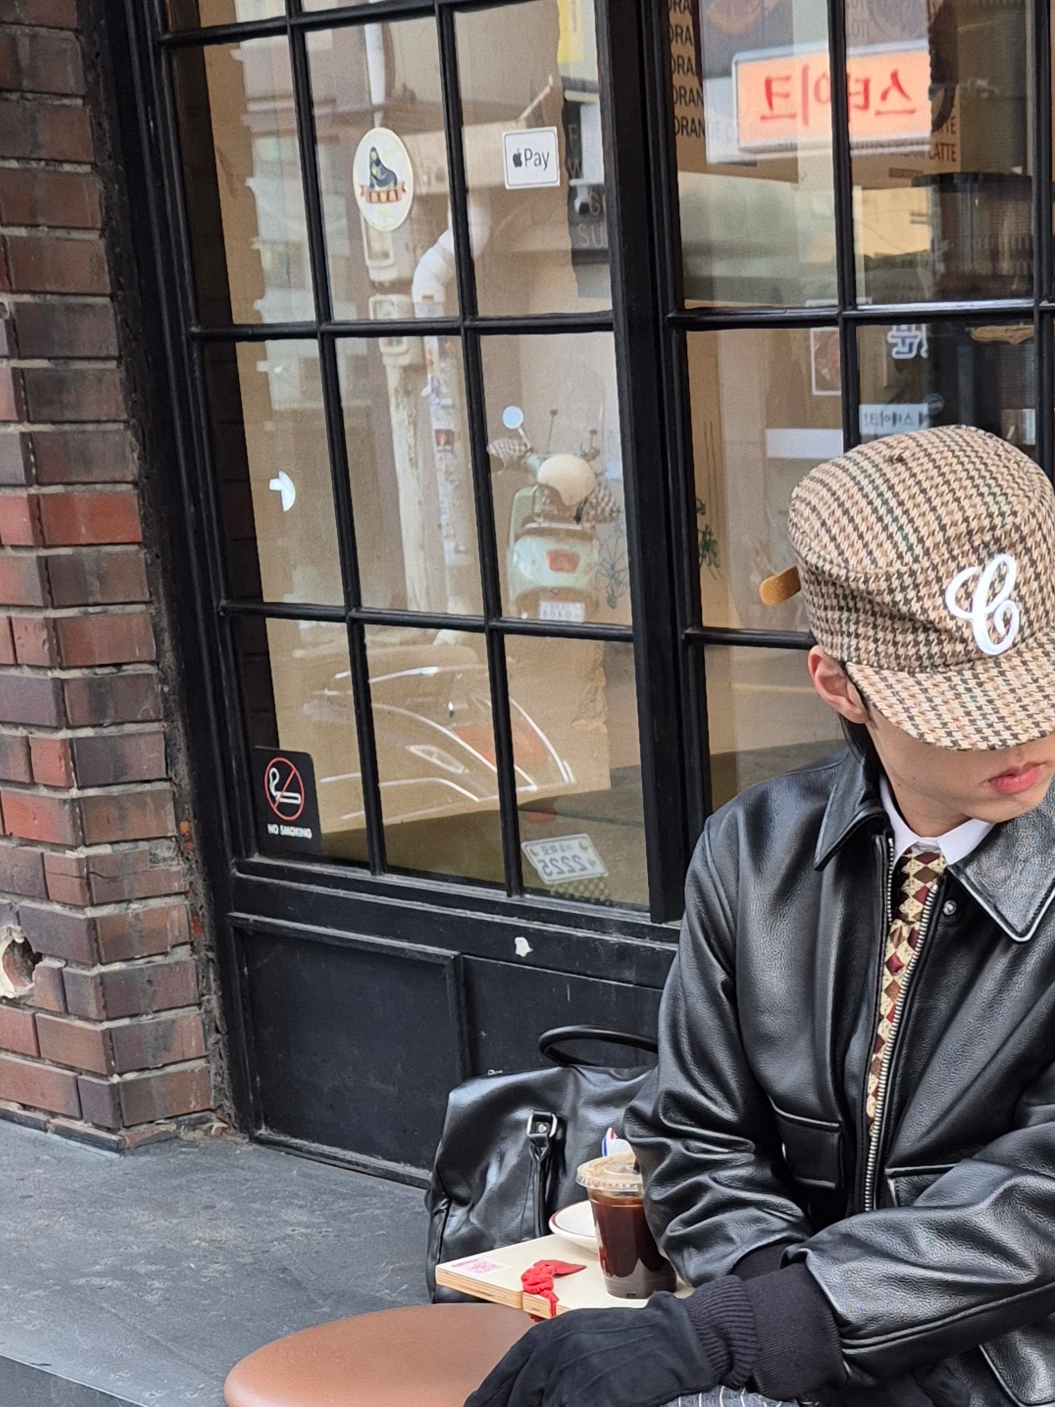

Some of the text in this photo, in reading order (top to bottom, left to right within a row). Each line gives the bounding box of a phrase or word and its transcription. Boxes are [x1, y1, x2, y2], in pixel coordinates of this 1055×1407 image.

[525, 147, 550, 171] Pay
[267, 823, 312, 839] NO SMOKING
